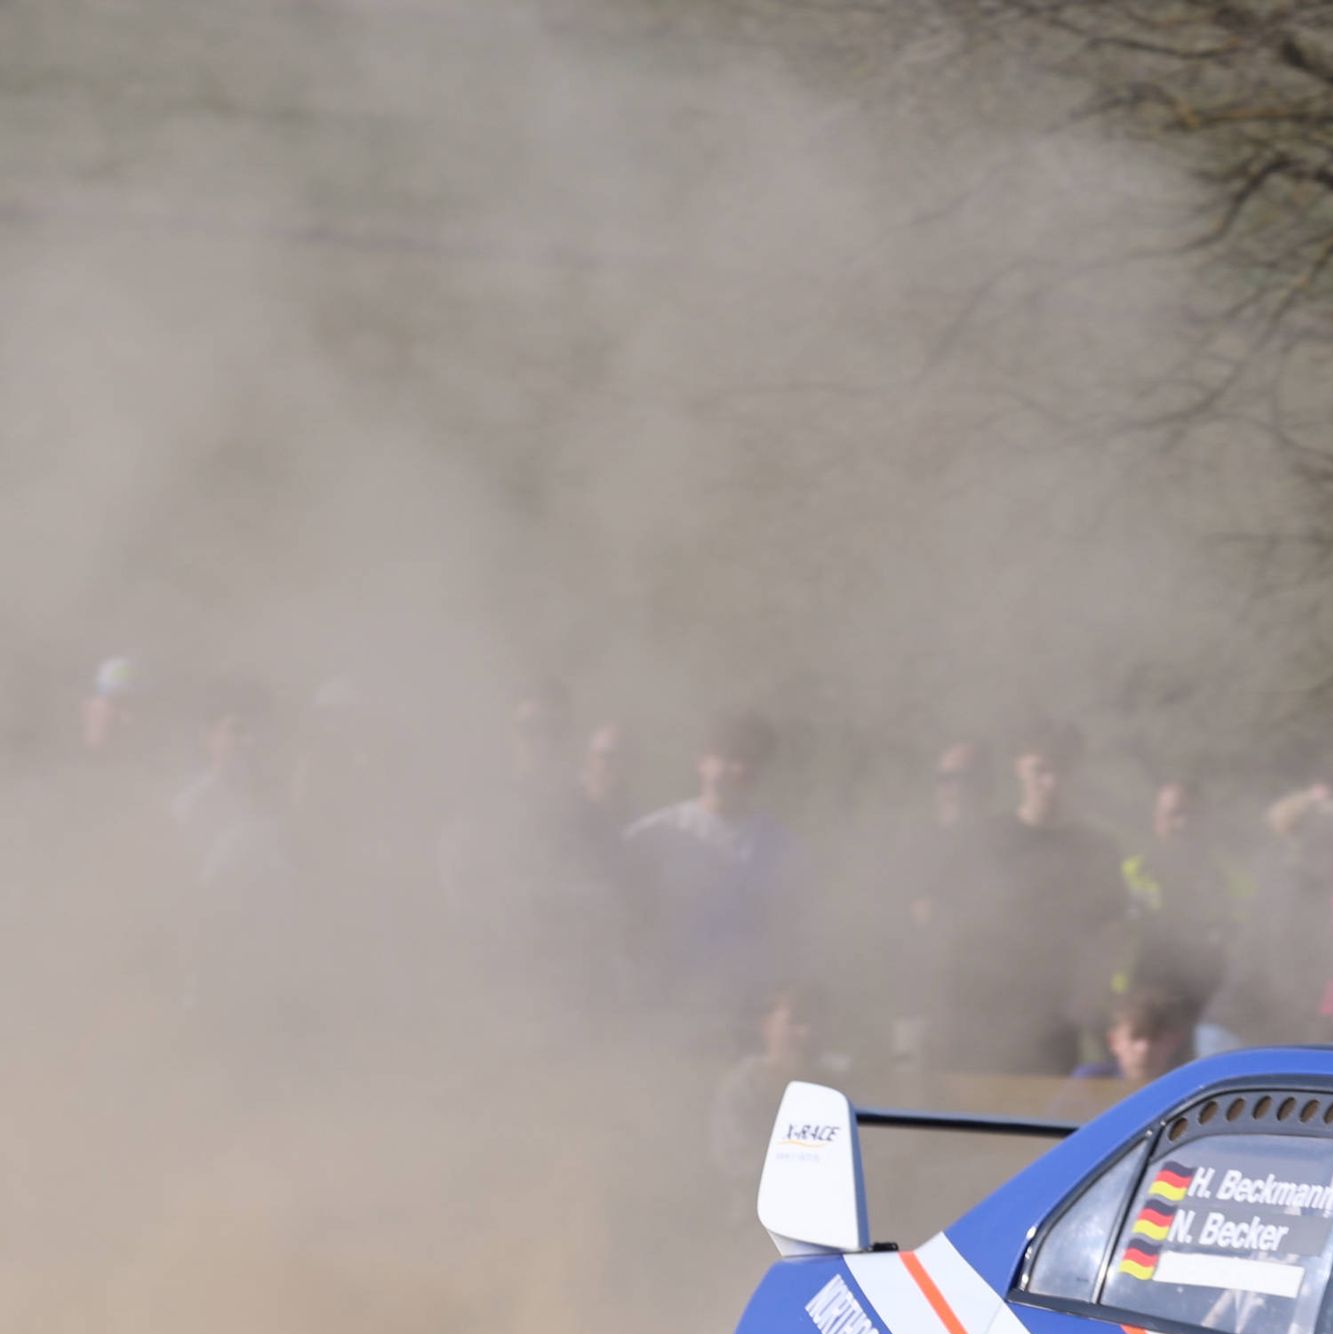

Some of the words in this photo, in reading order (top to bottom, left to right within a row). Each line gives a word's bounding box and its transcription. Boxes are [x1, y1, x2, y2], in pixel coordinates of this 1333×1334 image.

[1187, 1166, 1216, 1199] H.
[1167, 1209, 1197, 1244] N.
[1199, 1211, 1290, 1251] Becker
